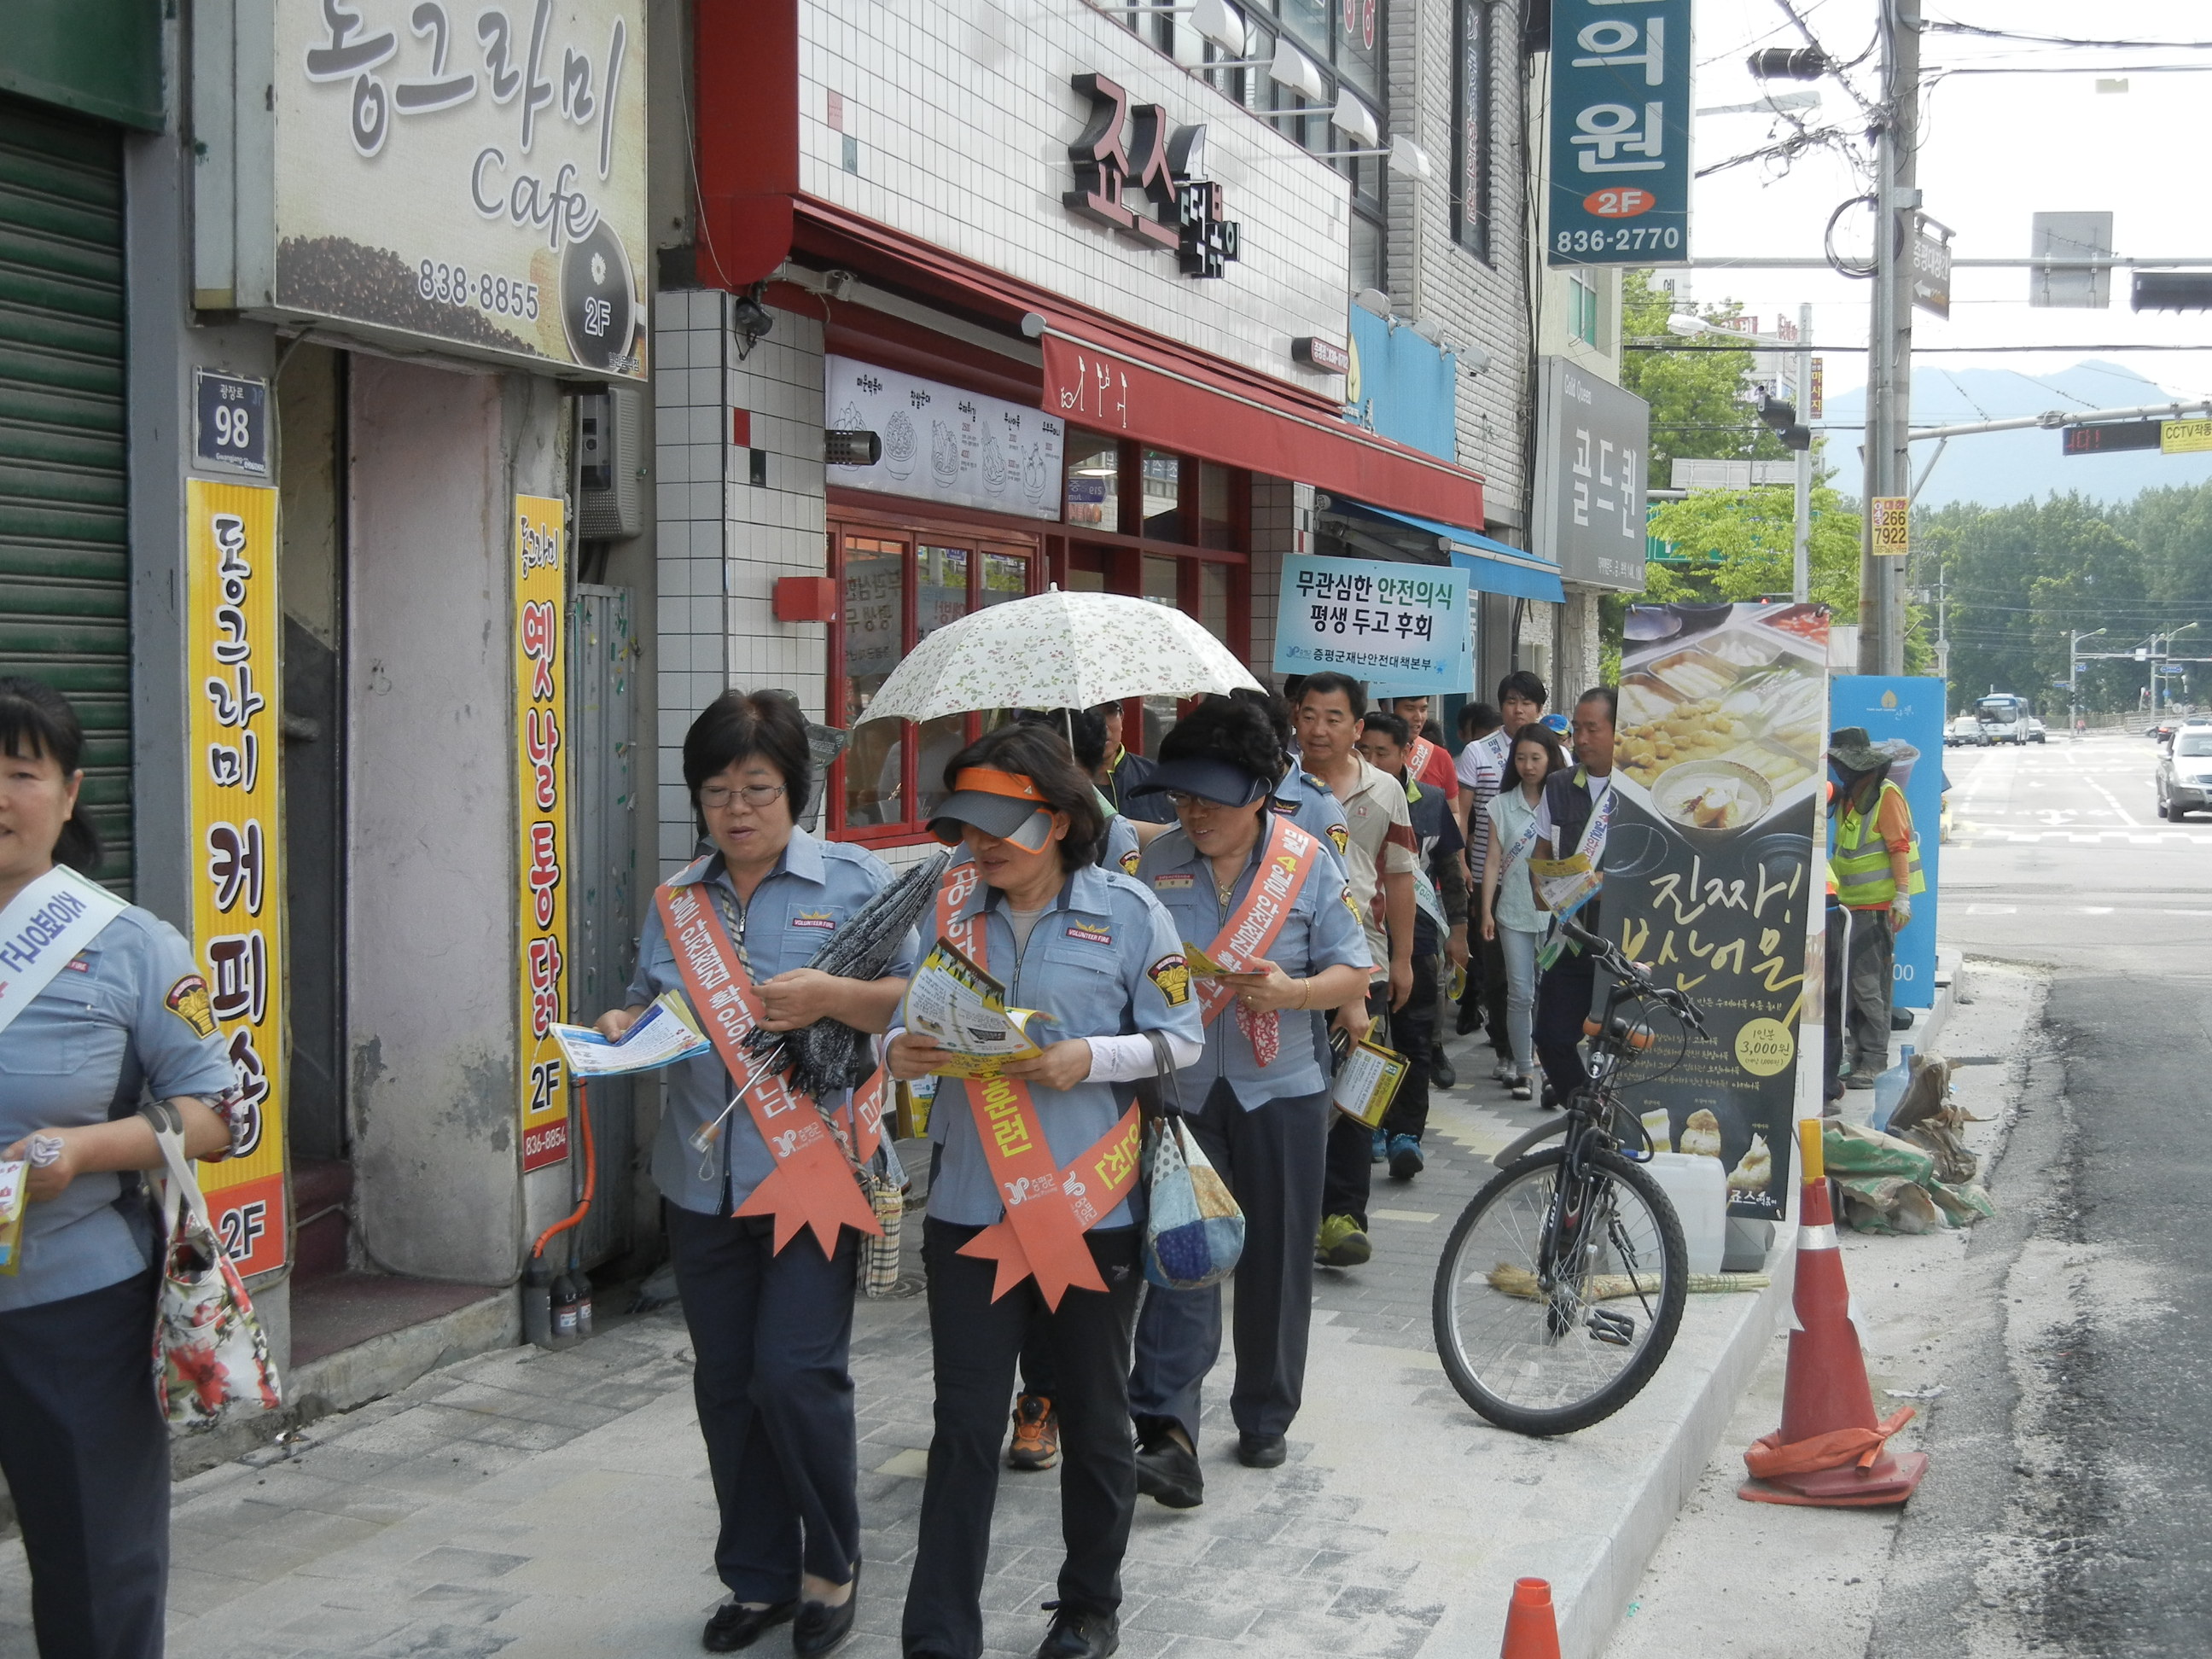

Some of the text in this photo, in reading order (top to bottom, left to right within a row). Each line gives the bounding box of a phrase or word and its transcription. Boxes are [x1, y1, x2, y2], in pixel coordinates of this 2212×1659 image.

[1570, 0, 1666, 173] 의원
[472, 148, 598, 248] Cafe
[1598, 191, 1642, 214] 2F
[1557, 227, 1679, 253] 836-2770
[585, 297, 611, 337] 2F
[219, 384, 245, 401] 광장로
[1565, 374, 1592, 405] Gold Queen
[1811, 370, 1821, 411] 마사지
[216, 405, 249, 448] 98
[1573, 427, 1637, 538] 골드퀸
[1875, 527, 1906, 544] 7922
[1883, 511, 1906, 526] 266
[521, 515, 559, 579] 동그라미
[1296, 570, 1453, 610] 무관심한 안전의식
[1310, 604, 1434, 642] 평생 두고 후회
[207, 514, 265, 795] 동그라미
[1313, 648, 1432, 672] 증평군재난안전대책본부
[1282, 829, 1312, 858] 매월
[1650, 855, 1802, 925] 진짜!
[795, 919, 834, 929] VOLUNTEER FIRE
[1068, 928, 1110, 944] VOLUNTEER FIRE
[1230, 894, 1280, 958] 안전점검
[680, 919, 731, 991] 안전점검
[1740, 1040, 1790, 1056] 3,000원
[1752, 1028, 1775, 1040] 1인분
[530, 1058, 562, 1115] 2F
[526, 1126, 566, 1156] 836-8854
[220, 1200, 266, 1263] 2F
